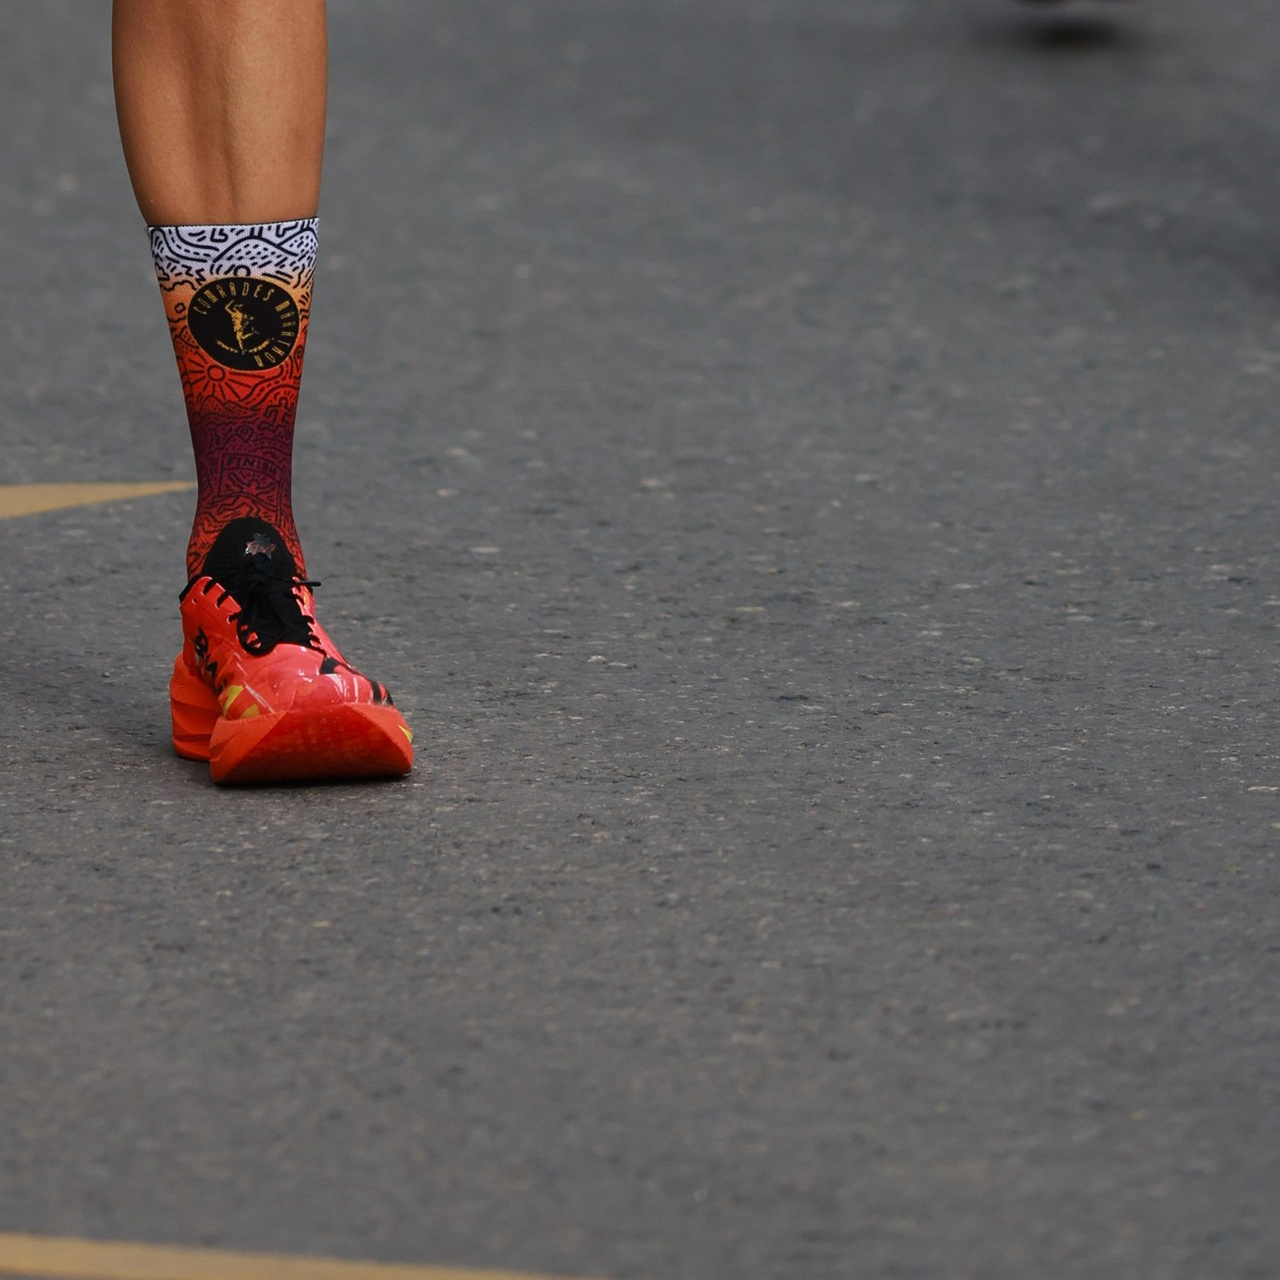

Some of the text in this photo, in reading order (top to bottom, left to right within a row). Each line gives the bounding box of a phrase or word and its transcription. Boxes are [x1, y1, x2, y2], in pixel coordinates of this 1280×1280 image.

[192, 281, 297, 368] COMRADES MARATHON
[226, 456, 277, 476] FINISH
